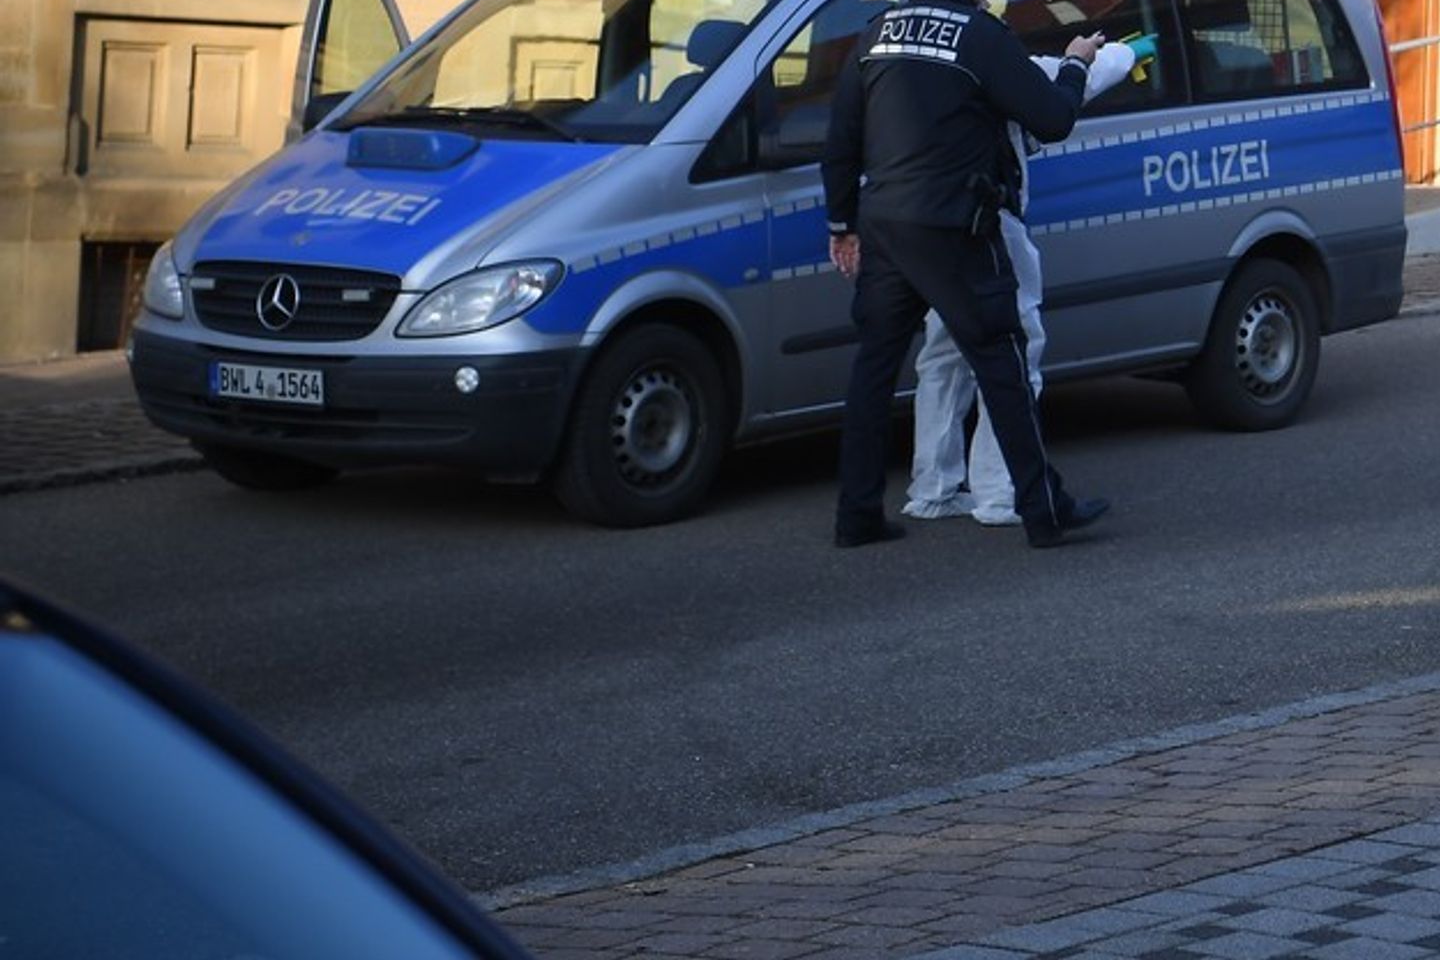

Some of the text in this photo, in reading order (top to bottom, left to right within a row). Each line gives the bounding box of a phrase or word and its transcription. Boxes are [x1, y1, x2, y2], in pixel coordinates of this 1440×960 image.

[878, 18, 963, 49] POLIZEI
[1142, 139, 1269, 197] POLIZEI
[253, 188, 443, 226] POLIZEI
[220, 367, 320, 401] BWL 4 1564
